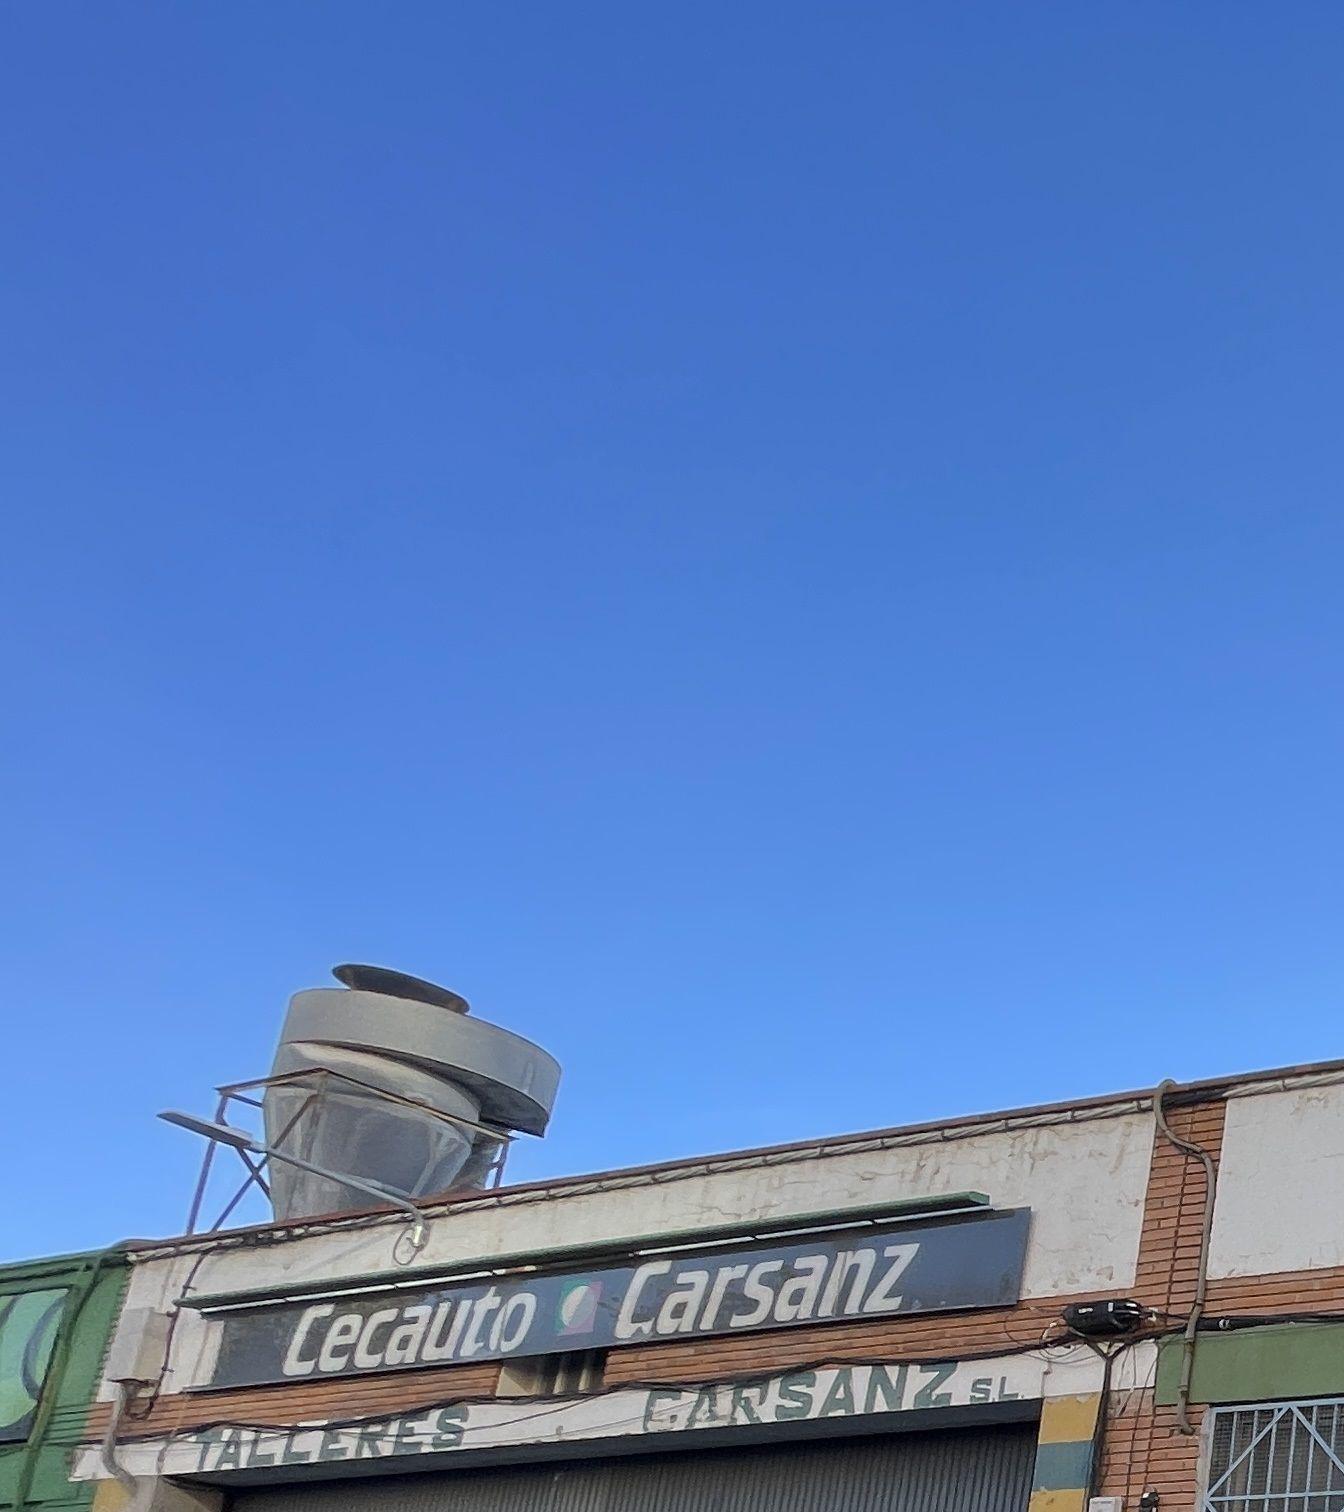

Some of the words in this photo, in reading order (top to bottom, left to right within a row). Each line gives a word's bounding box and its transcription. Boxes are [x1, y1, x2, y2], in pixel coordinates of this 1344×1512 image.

[282, 1286, 537, 1376] Cecauto
[614, 1242, 920, 1340] Carsanz
[195, 1403, 470, 1472] TALLERES
